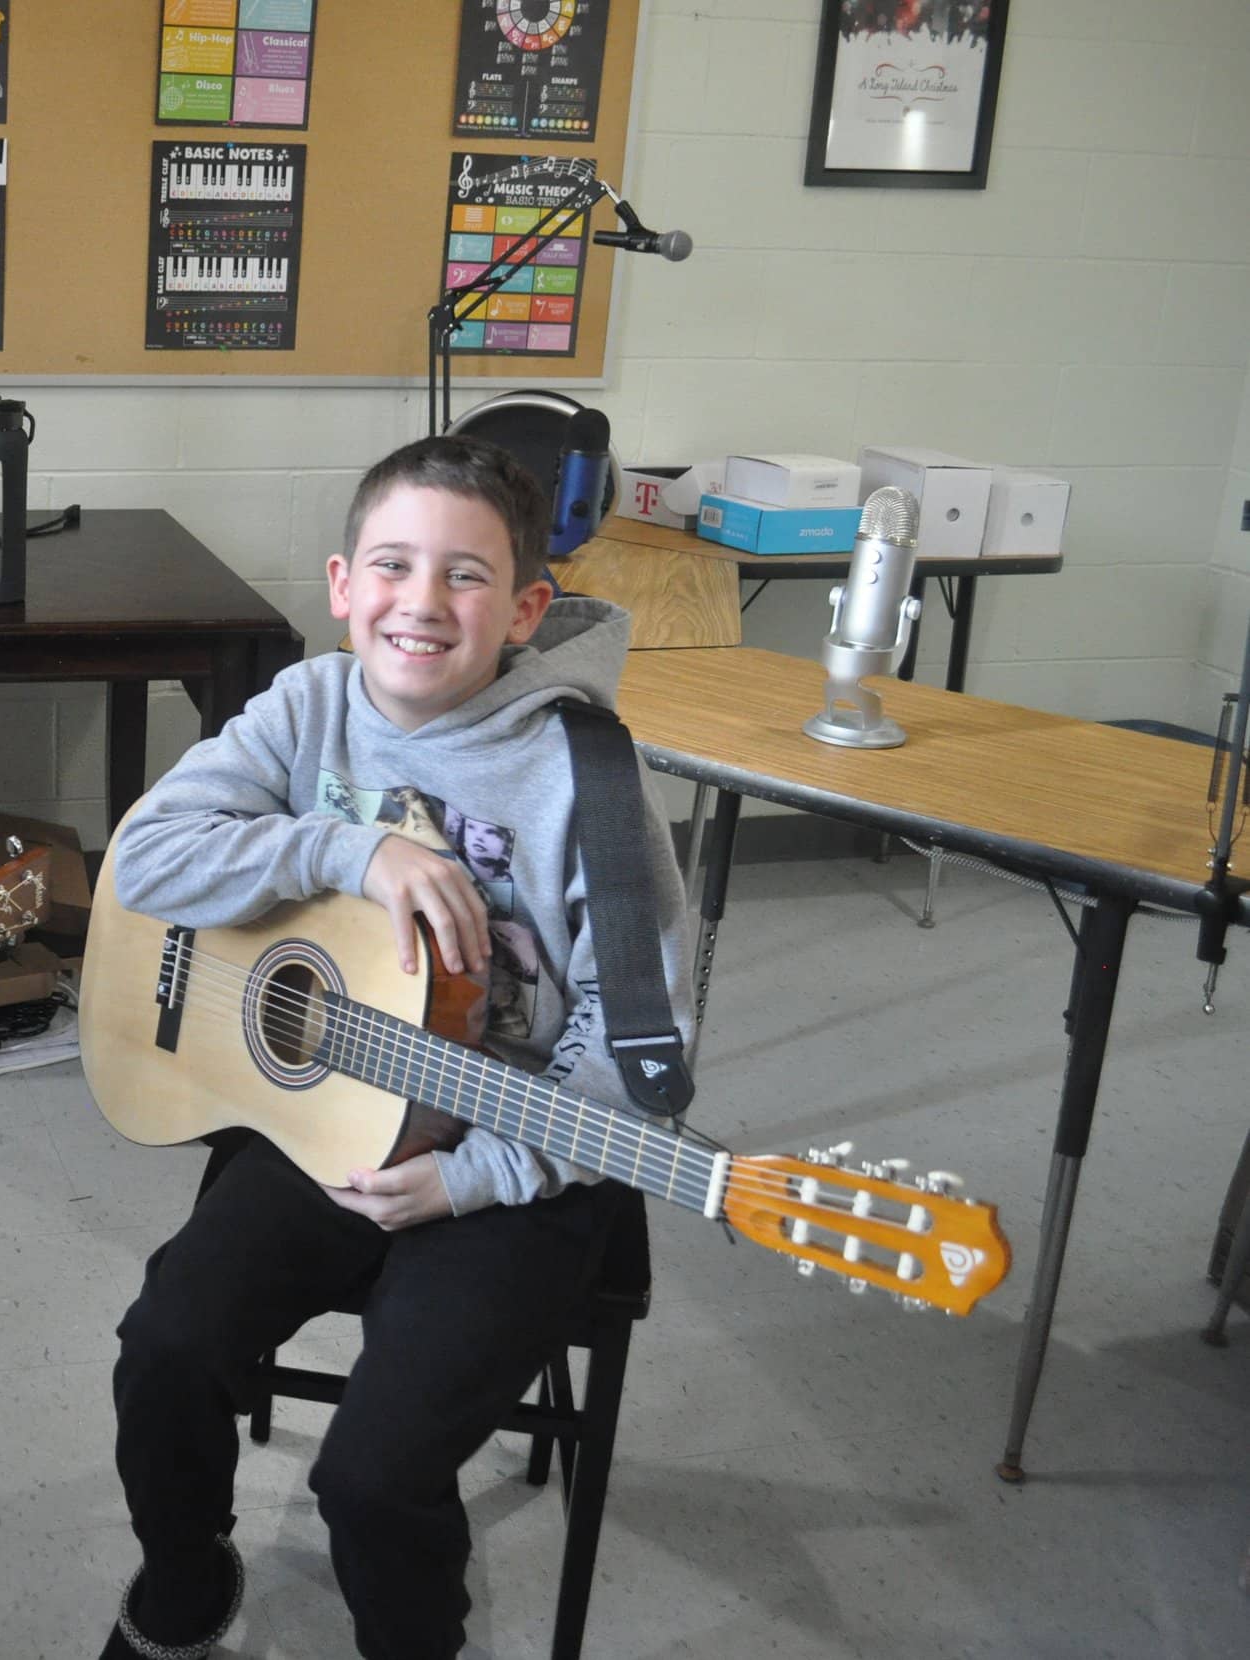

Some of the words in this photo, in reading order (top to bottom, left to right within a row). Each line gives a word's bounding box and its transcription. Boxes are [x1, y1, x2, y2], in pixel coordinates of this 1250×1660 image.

[189, 32, 233, 46] Hip-Hop
[262, 36, 307, 48] Classical
[482, 73, 502, 81] FLATS
[551, 77, 578, 85] SHARPS
[195, 79, 223, 91] Disco
[268, 83, 295, 94] Blues
[184, 147, 225, 159] BASIC
[229, 149, 274, 161] NOTES
[494, 184, 533, 196] MUSIC
[505, 196, 534, 206] BASIC
[799, 527, 834, 537] zmodo
